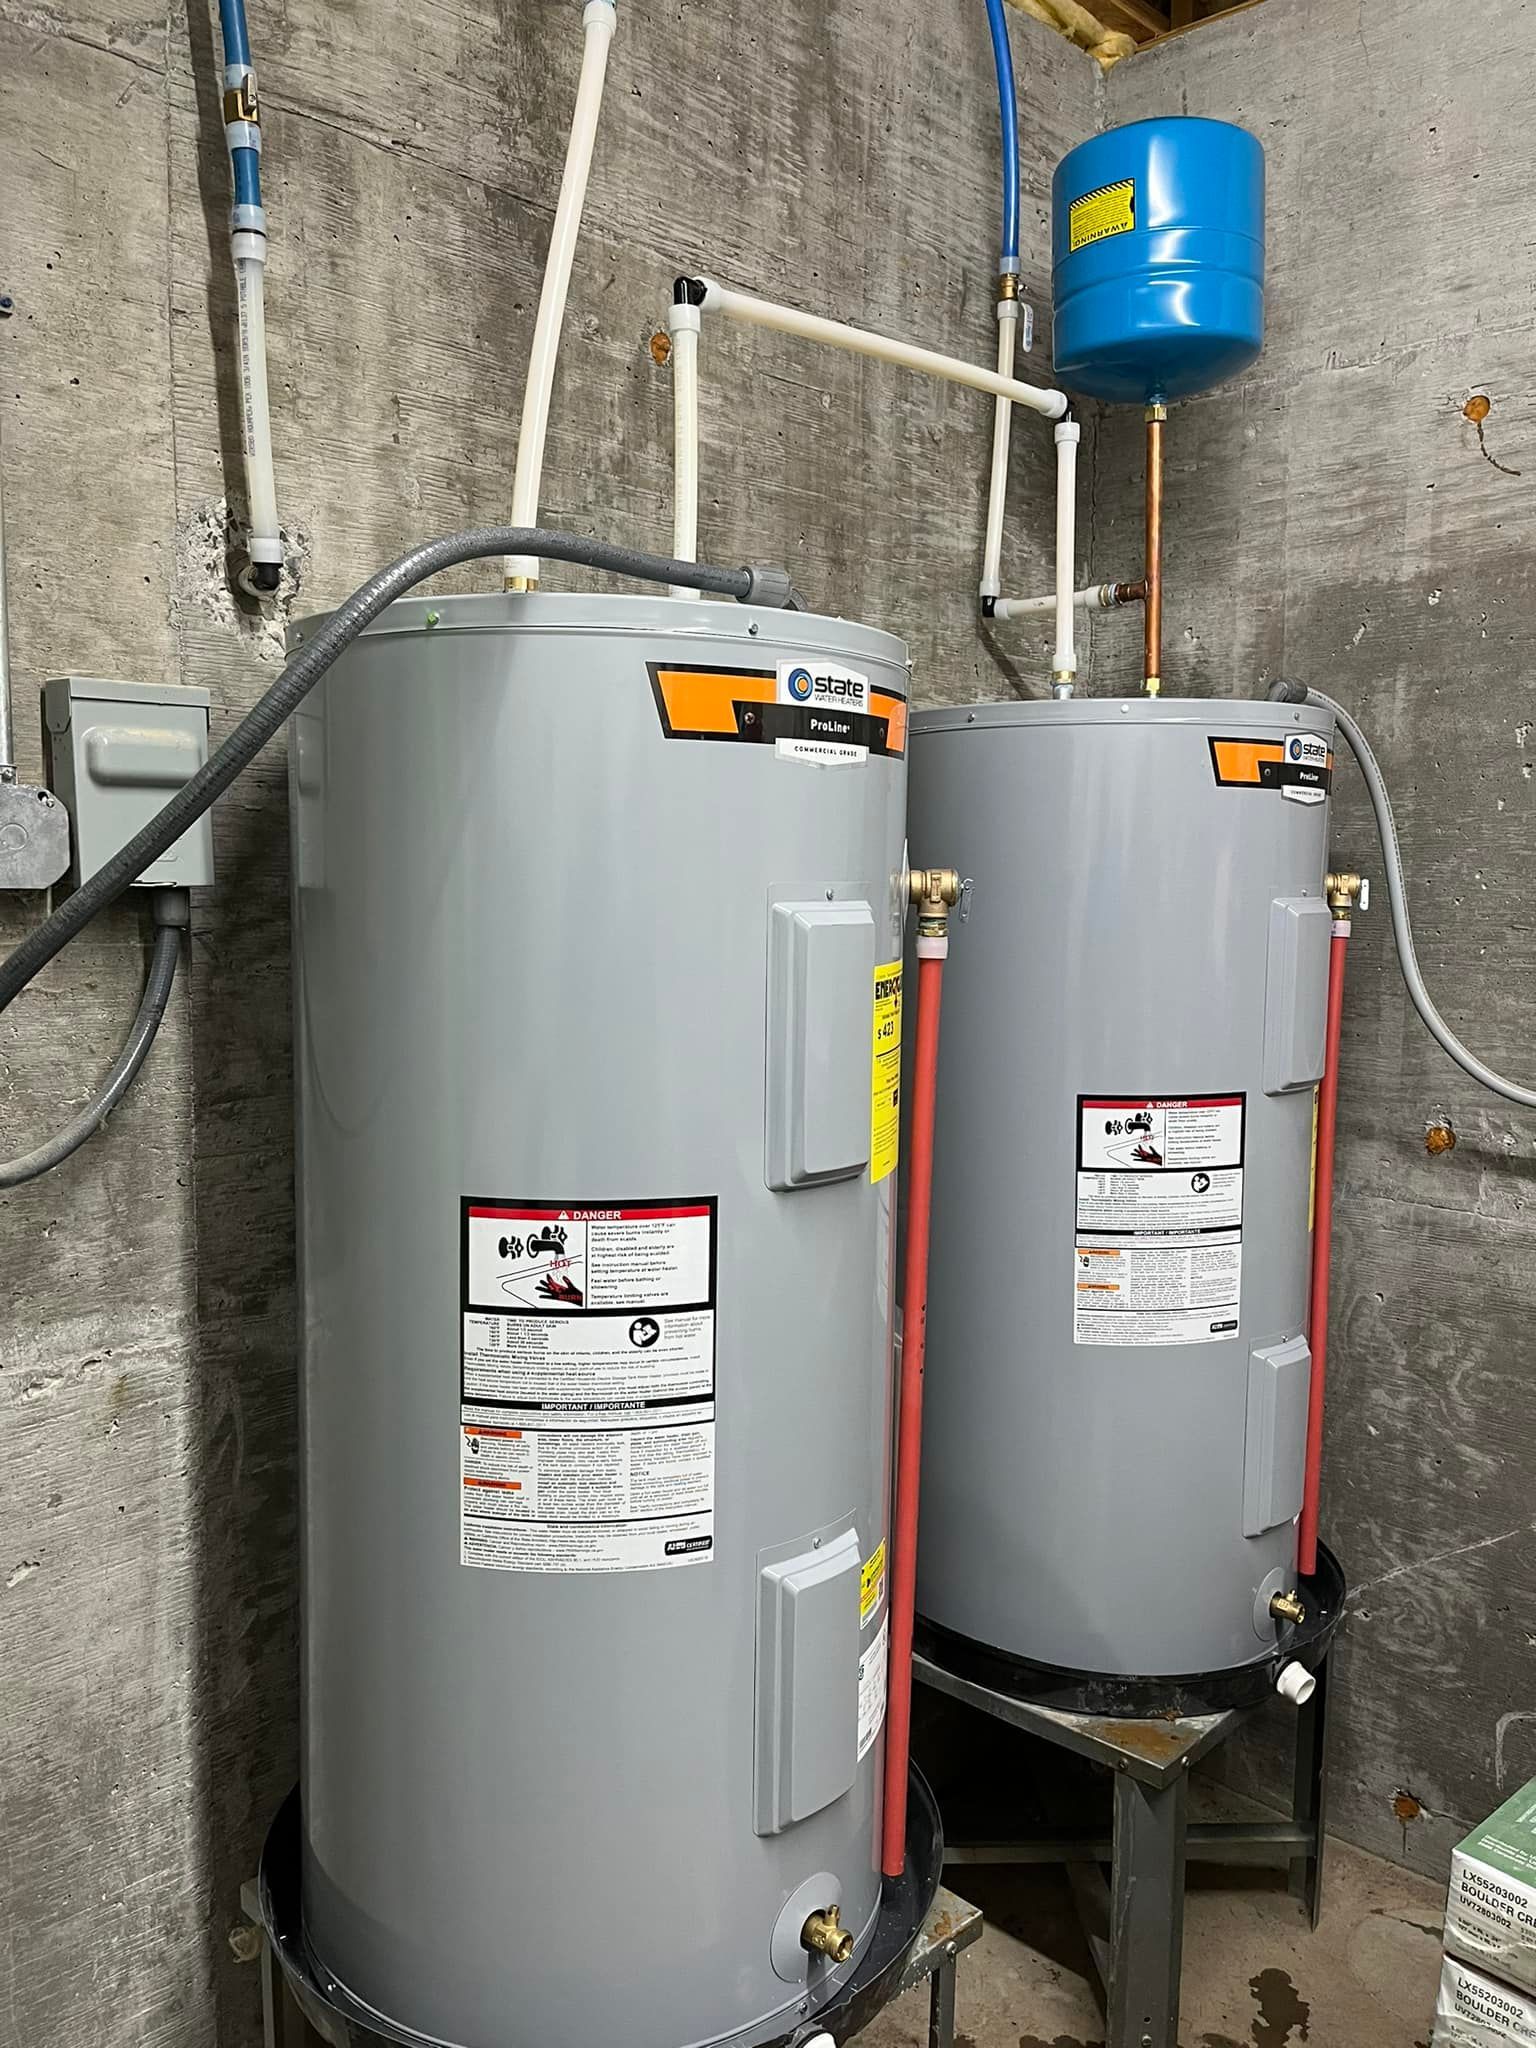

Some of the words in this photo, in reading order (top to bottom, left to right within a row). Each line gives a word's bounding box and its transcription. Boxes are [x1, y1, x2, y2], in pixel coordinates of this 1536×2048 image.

[815, 676, 864, 698] state
[815, 694, 835, 703] WATER
[794, 745, 837, 755] COMMERCIAL
[839, 749, 857, 757] GRADE
[1303, 742, 1326, 757] state
[882, 1020, 894, 1036] 423
[1156, 1101, 1188, 1109] DANGER
[573, 1211, 622, 1220] DANGER
[593, 1401, 646, 1410] IMPORTANTE
[1463, 1869, 1528, 1908] LX55203002
[1461, 1882, 1514, 1917] BOULDER
[1460, 1895, 1512, 1929] UV72803002
[1458, 1976, 1523, 2019] LX55203002
[1456, 1989, 1510, 2027] BOULDER
